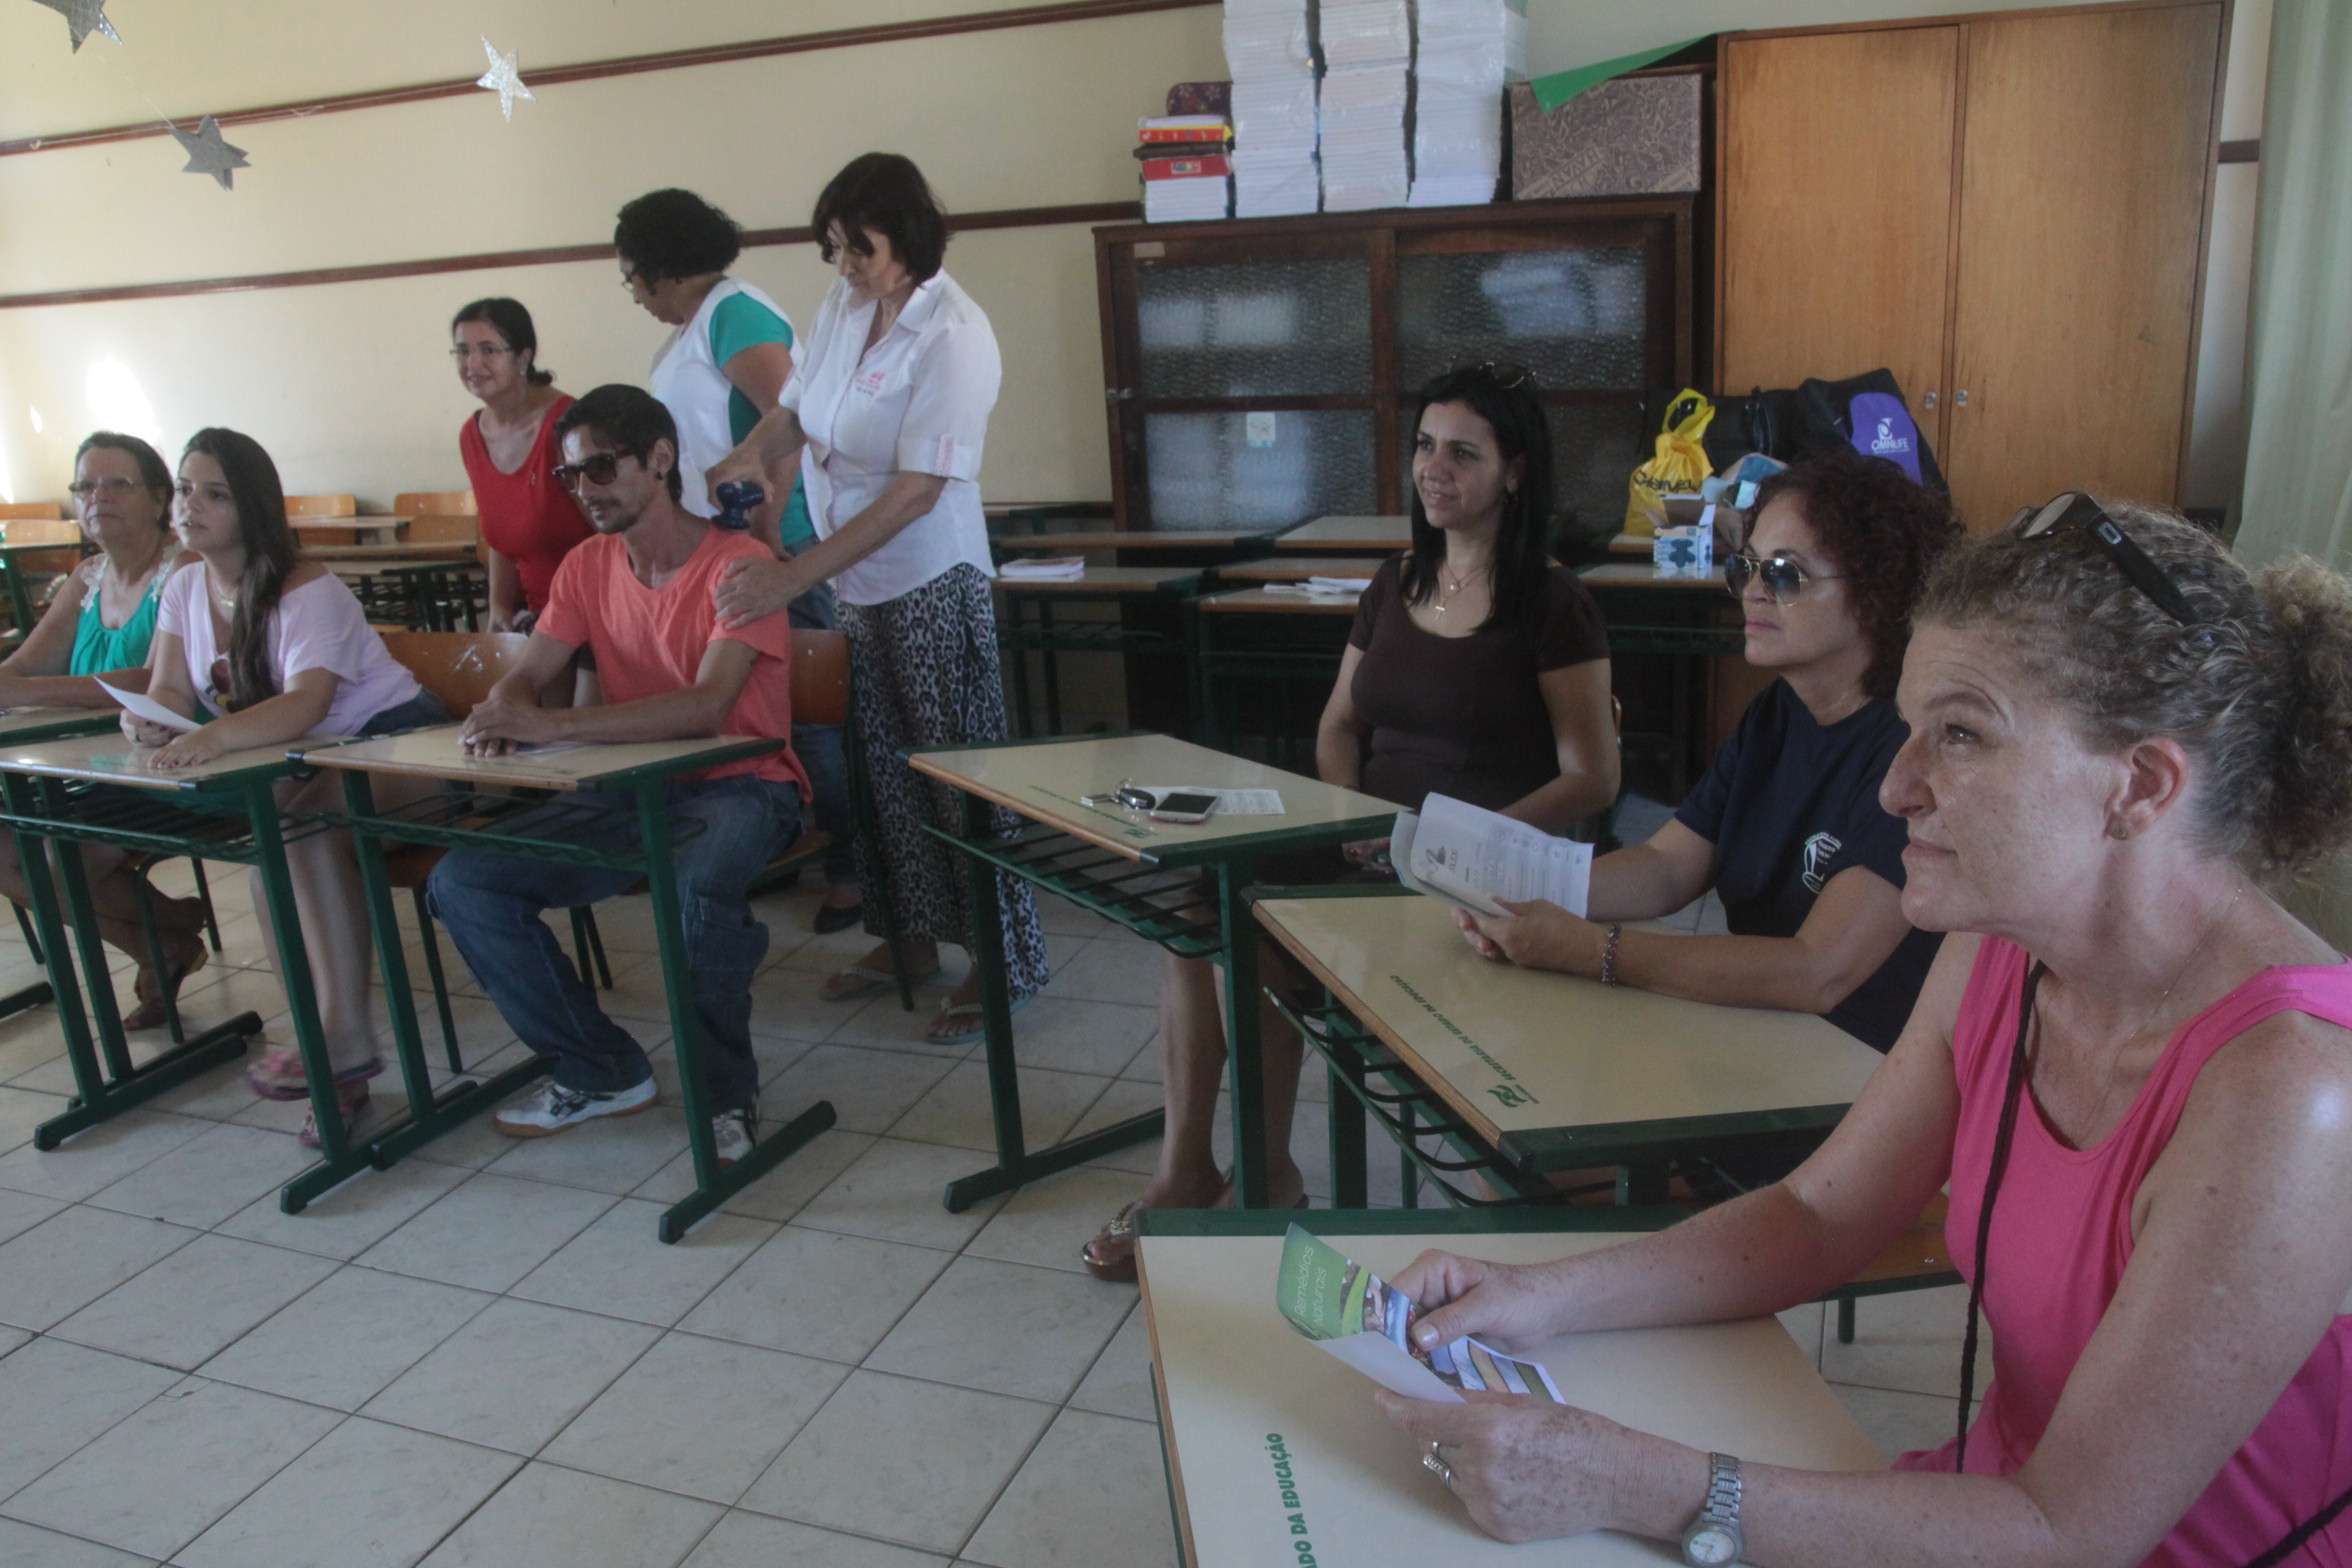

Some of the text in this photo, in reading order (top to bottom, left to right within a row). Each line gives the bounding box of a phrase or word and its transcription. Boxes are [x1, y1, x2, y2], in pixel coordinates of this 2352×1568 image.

[1551, 149, 1600, 186] HAVAN
[1871, 437, 1909, 451] OMNILIFE
[1421, 1004, 1437, 1014] DA
[1432, 1013, 1463, 1036] ESTADO
[1457, 1035, 1473, 1045] DE
[1470, 1044, 1517, 1081] SECRETARIA
[1294, 1245, 1314, 1317] Remédios
[1311, 1266, 1327, 1325] Naturais
[1264, 1432, 1301, 1509] EDUCAÇÃO
[1287, 1512, 1308, 1535] DA
